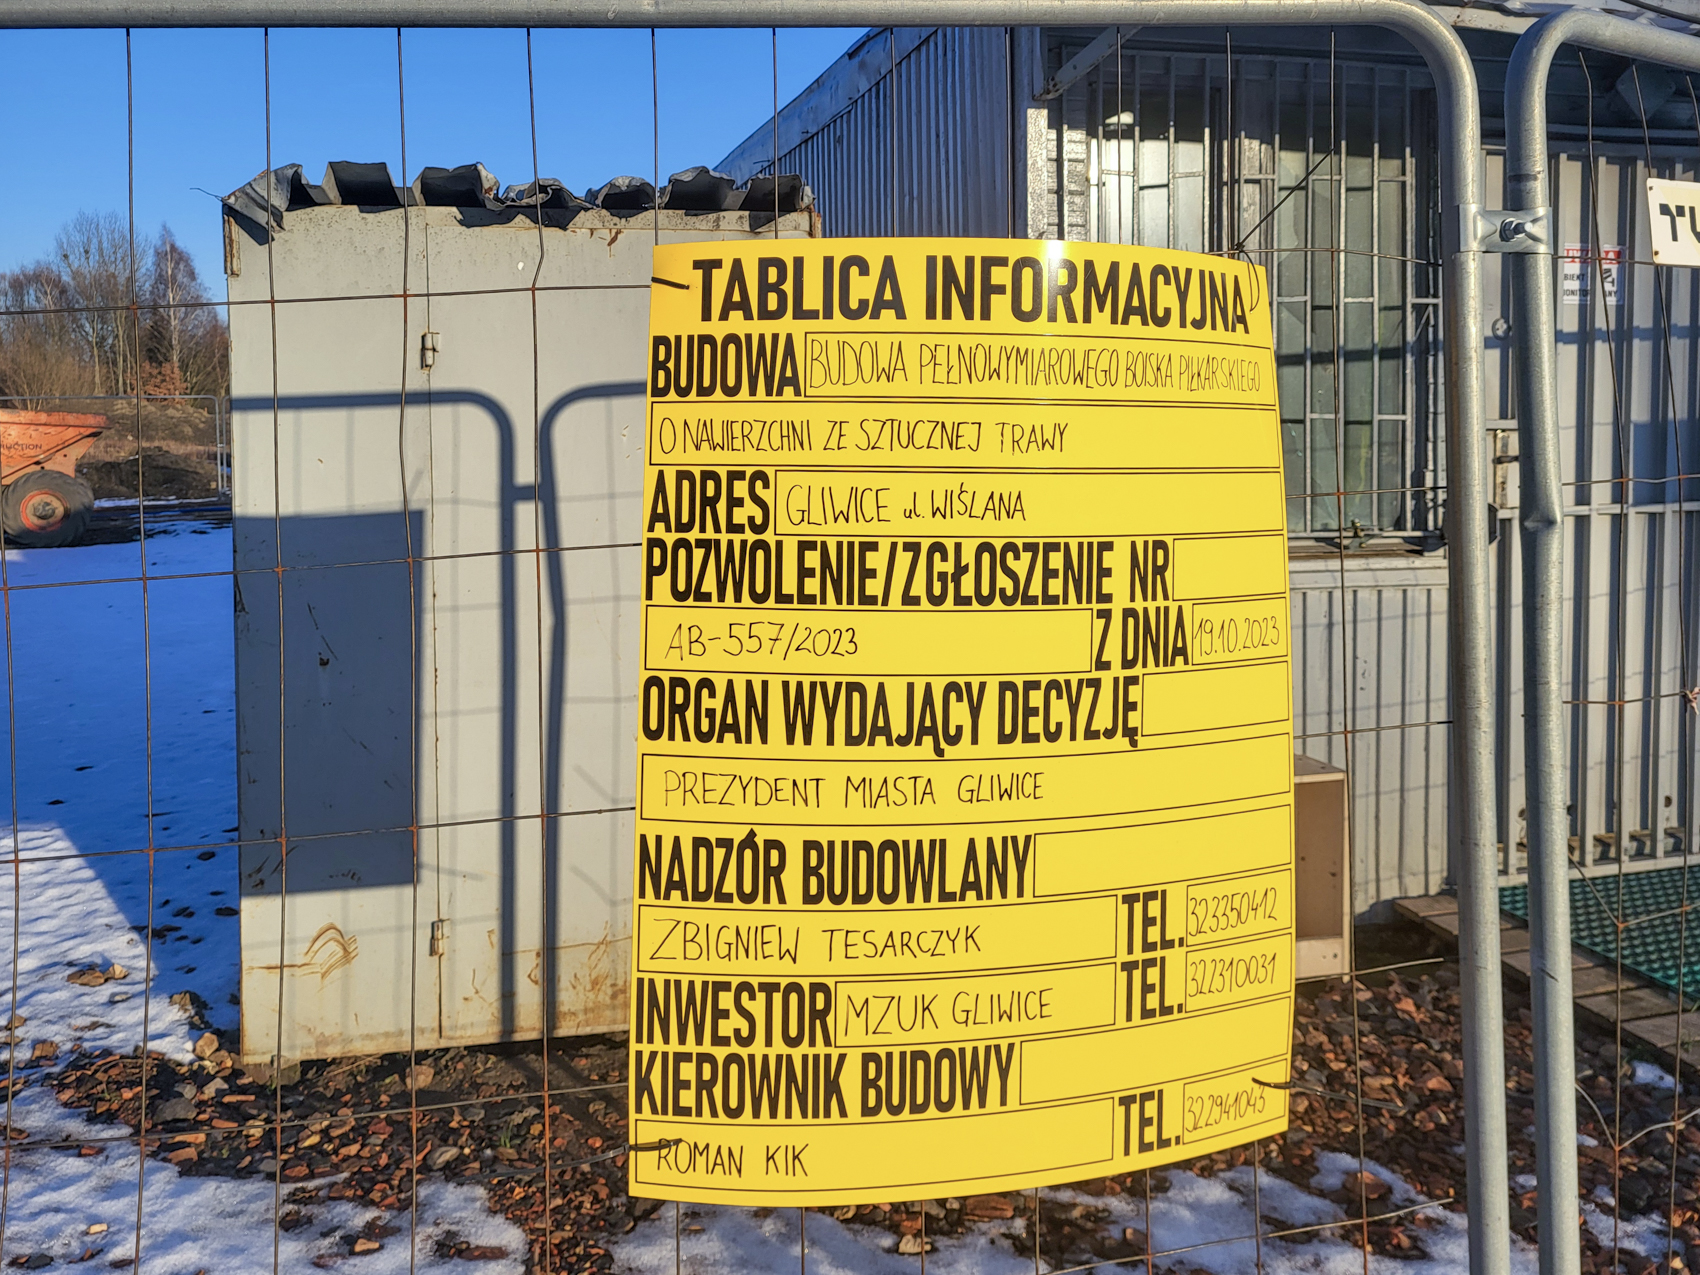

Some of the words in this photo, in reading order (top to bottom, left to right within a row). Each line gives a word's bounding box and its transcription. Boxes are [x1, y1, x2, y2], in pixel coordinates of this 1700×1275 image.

[692, 255, 907, 322] TABLICA
[925, 255, 1250, 335] INFORMACYJNA
[650, 332, 803, 398] BUDOWA
[809, 338, 908, 389] BUDOWA
[919, 343, 1120, 389] PEŁNOWYMIAROWEGO
[1124, 350, 1174, 389] BOISKA
[1178, 353, 1261, 392] PIŁKARSKIEGO
[658, 417, 677, 454] O
[683, 417, 813, 453] NAWIERZCHNI
[822, 419, 850, 451] ZE
[855, 418, 982, 452] SZTUCZNEJ
[995, 421, 1069, 456] TRAWY
[646, 469, 771, 536] ADRES
[786, 484, 892, 526] GLIWICE
[931, 482, 1026, 521] WIŚLANA
[645, 537, 1114, 607] POZWOLENIE/ZGŁOSZENIE
[1129, 539, 1170, 603] NR
[664, 621, 859, 661] AB-557/2023
[1094, 608, 1112, 672] Z
[1121, 604, 1190, 671] DNIA
[1193, 615, 1281, 657] 19.10.2023
[641, 675, 770, 745] ORGAN
[781, 680, 988, 758] WYDAJĄCY
[997, 674, 1141, 749] DECYZJĘ
[664, 769, 827, 808] PREZYDENT
[844, 774, 936, 809] MIASTA
[957, 771, 1046, 805] GLIWICE
[638, 827, 788, 905] NADZÓR
[801, 834, 1033, 906] BUDOWLANY
[648, 917, 801, 965] ZBIGNIEW
[821, 924, 982, 962] TESARCZYK
[1121, 889, 1185, 956] TEL.
[1188, 887, 1278, 937] 323350412
[1120, 955, 1184, 1023] TEL.
[1187, 952, 1278, 998] 322310031
[634, 976, 834, 1048] INWESTOR
[844, 992, 940, 1037] MZUK
[951, 987, 1054, 1028] GLIWICE
[633, 1049, 849, 1120] KIEROWNIK
[859, 1042, 1016, 1118] BUDOWY
[1117, 1088, 1181, 1157] TEL.
[656, 1137, 744, 1179] ROMAN
[765, 1143, 810, 1178] KIK
